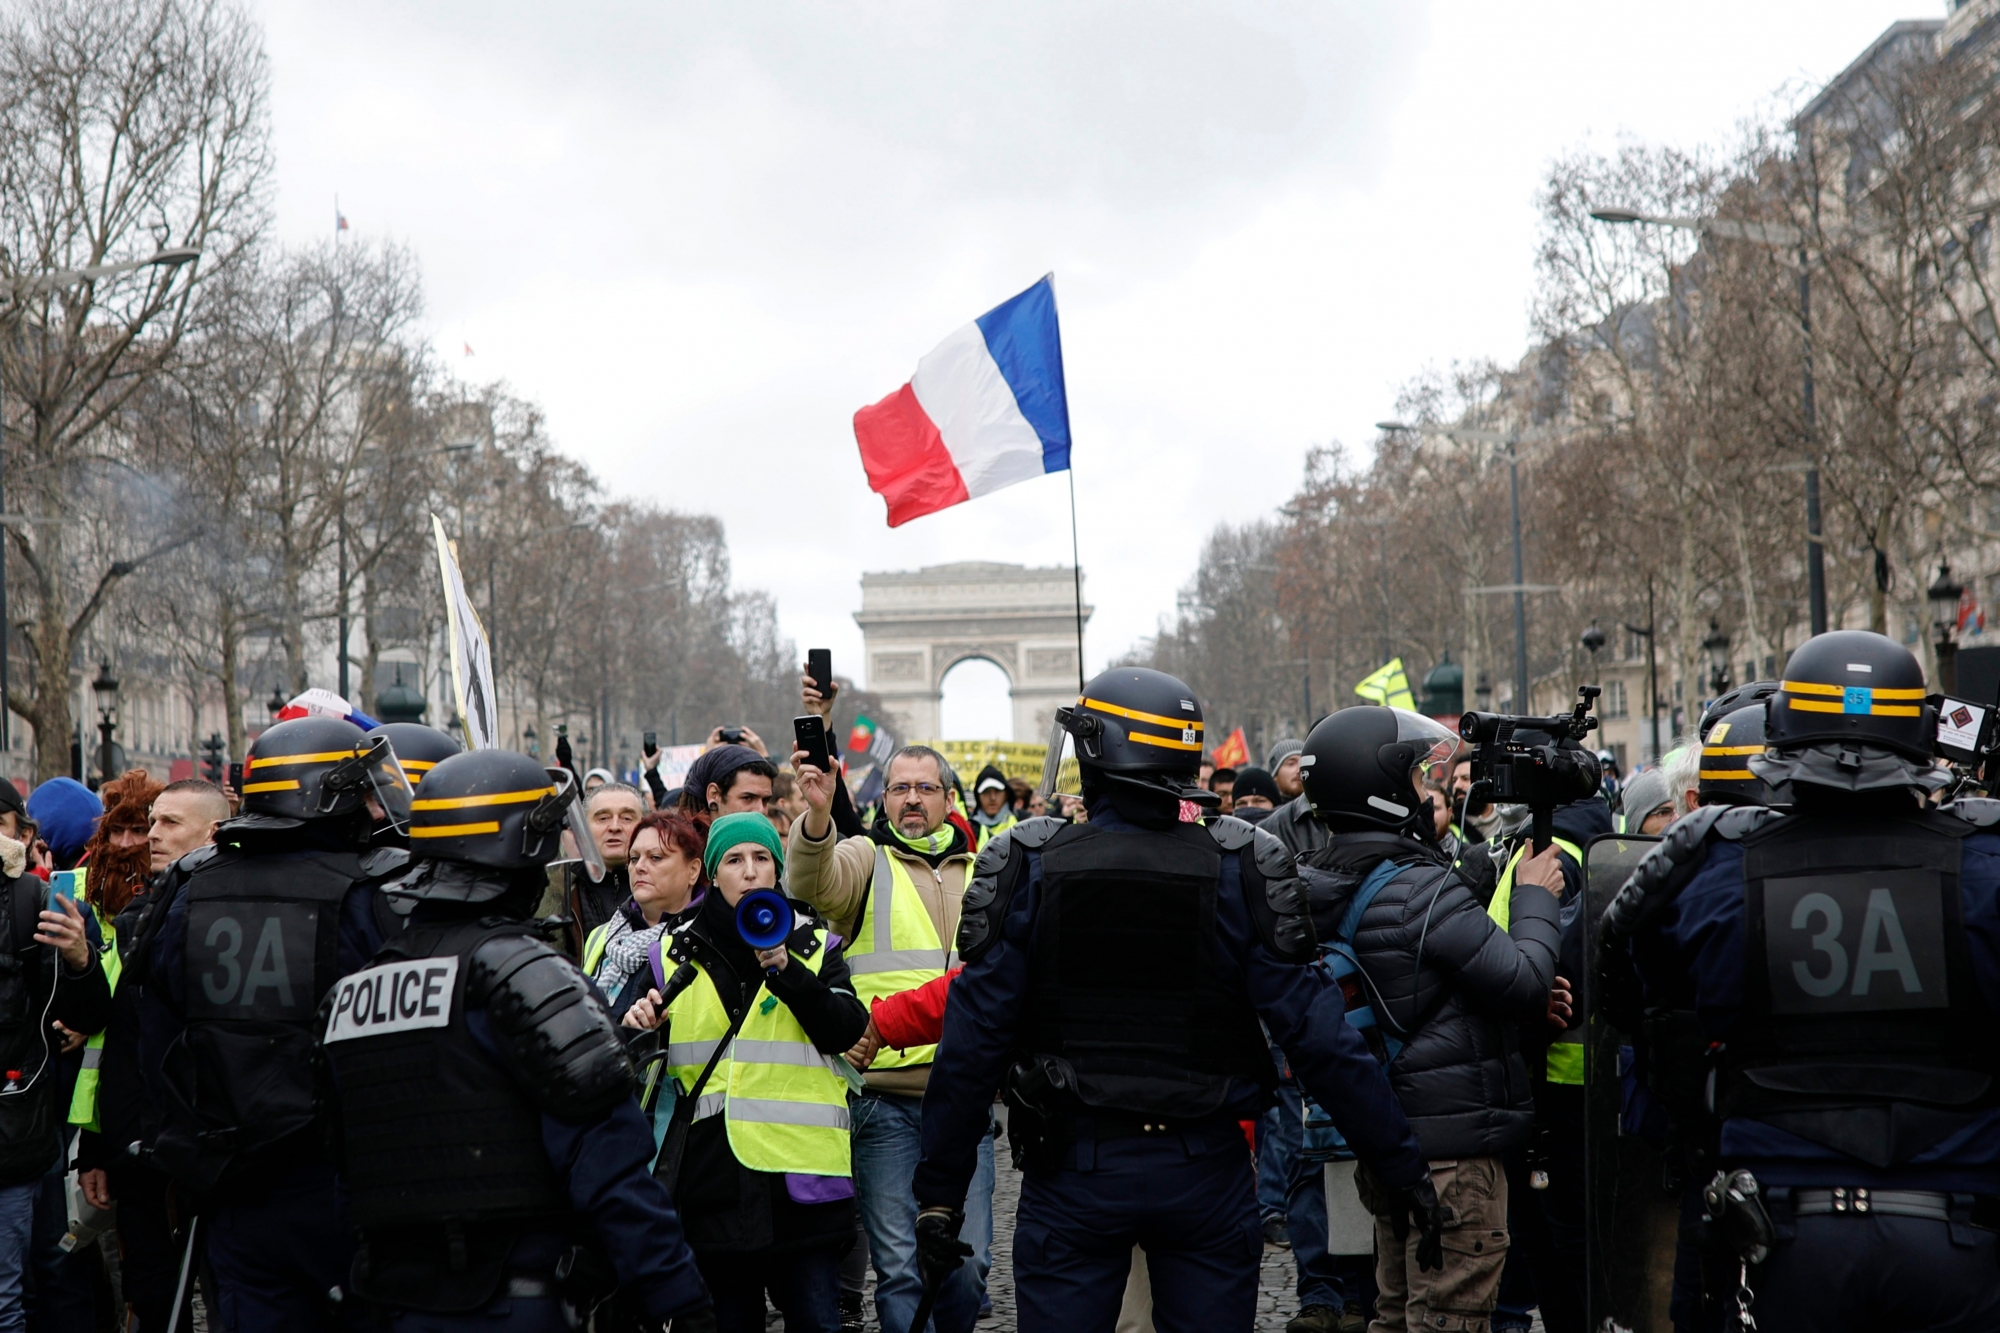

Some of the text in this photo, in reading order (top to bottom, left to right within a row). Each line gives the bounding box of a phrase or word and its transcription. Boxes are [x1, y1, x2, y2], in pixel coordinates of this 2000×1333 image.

[1847, 693, 1864, 704] 35
[1184, 732, 1194, 742] 35
[202, 916, 295, 1006] 3A
[1790, 888, 1924, 997] 3A
[332, 968, 448, 1033] POLICE
